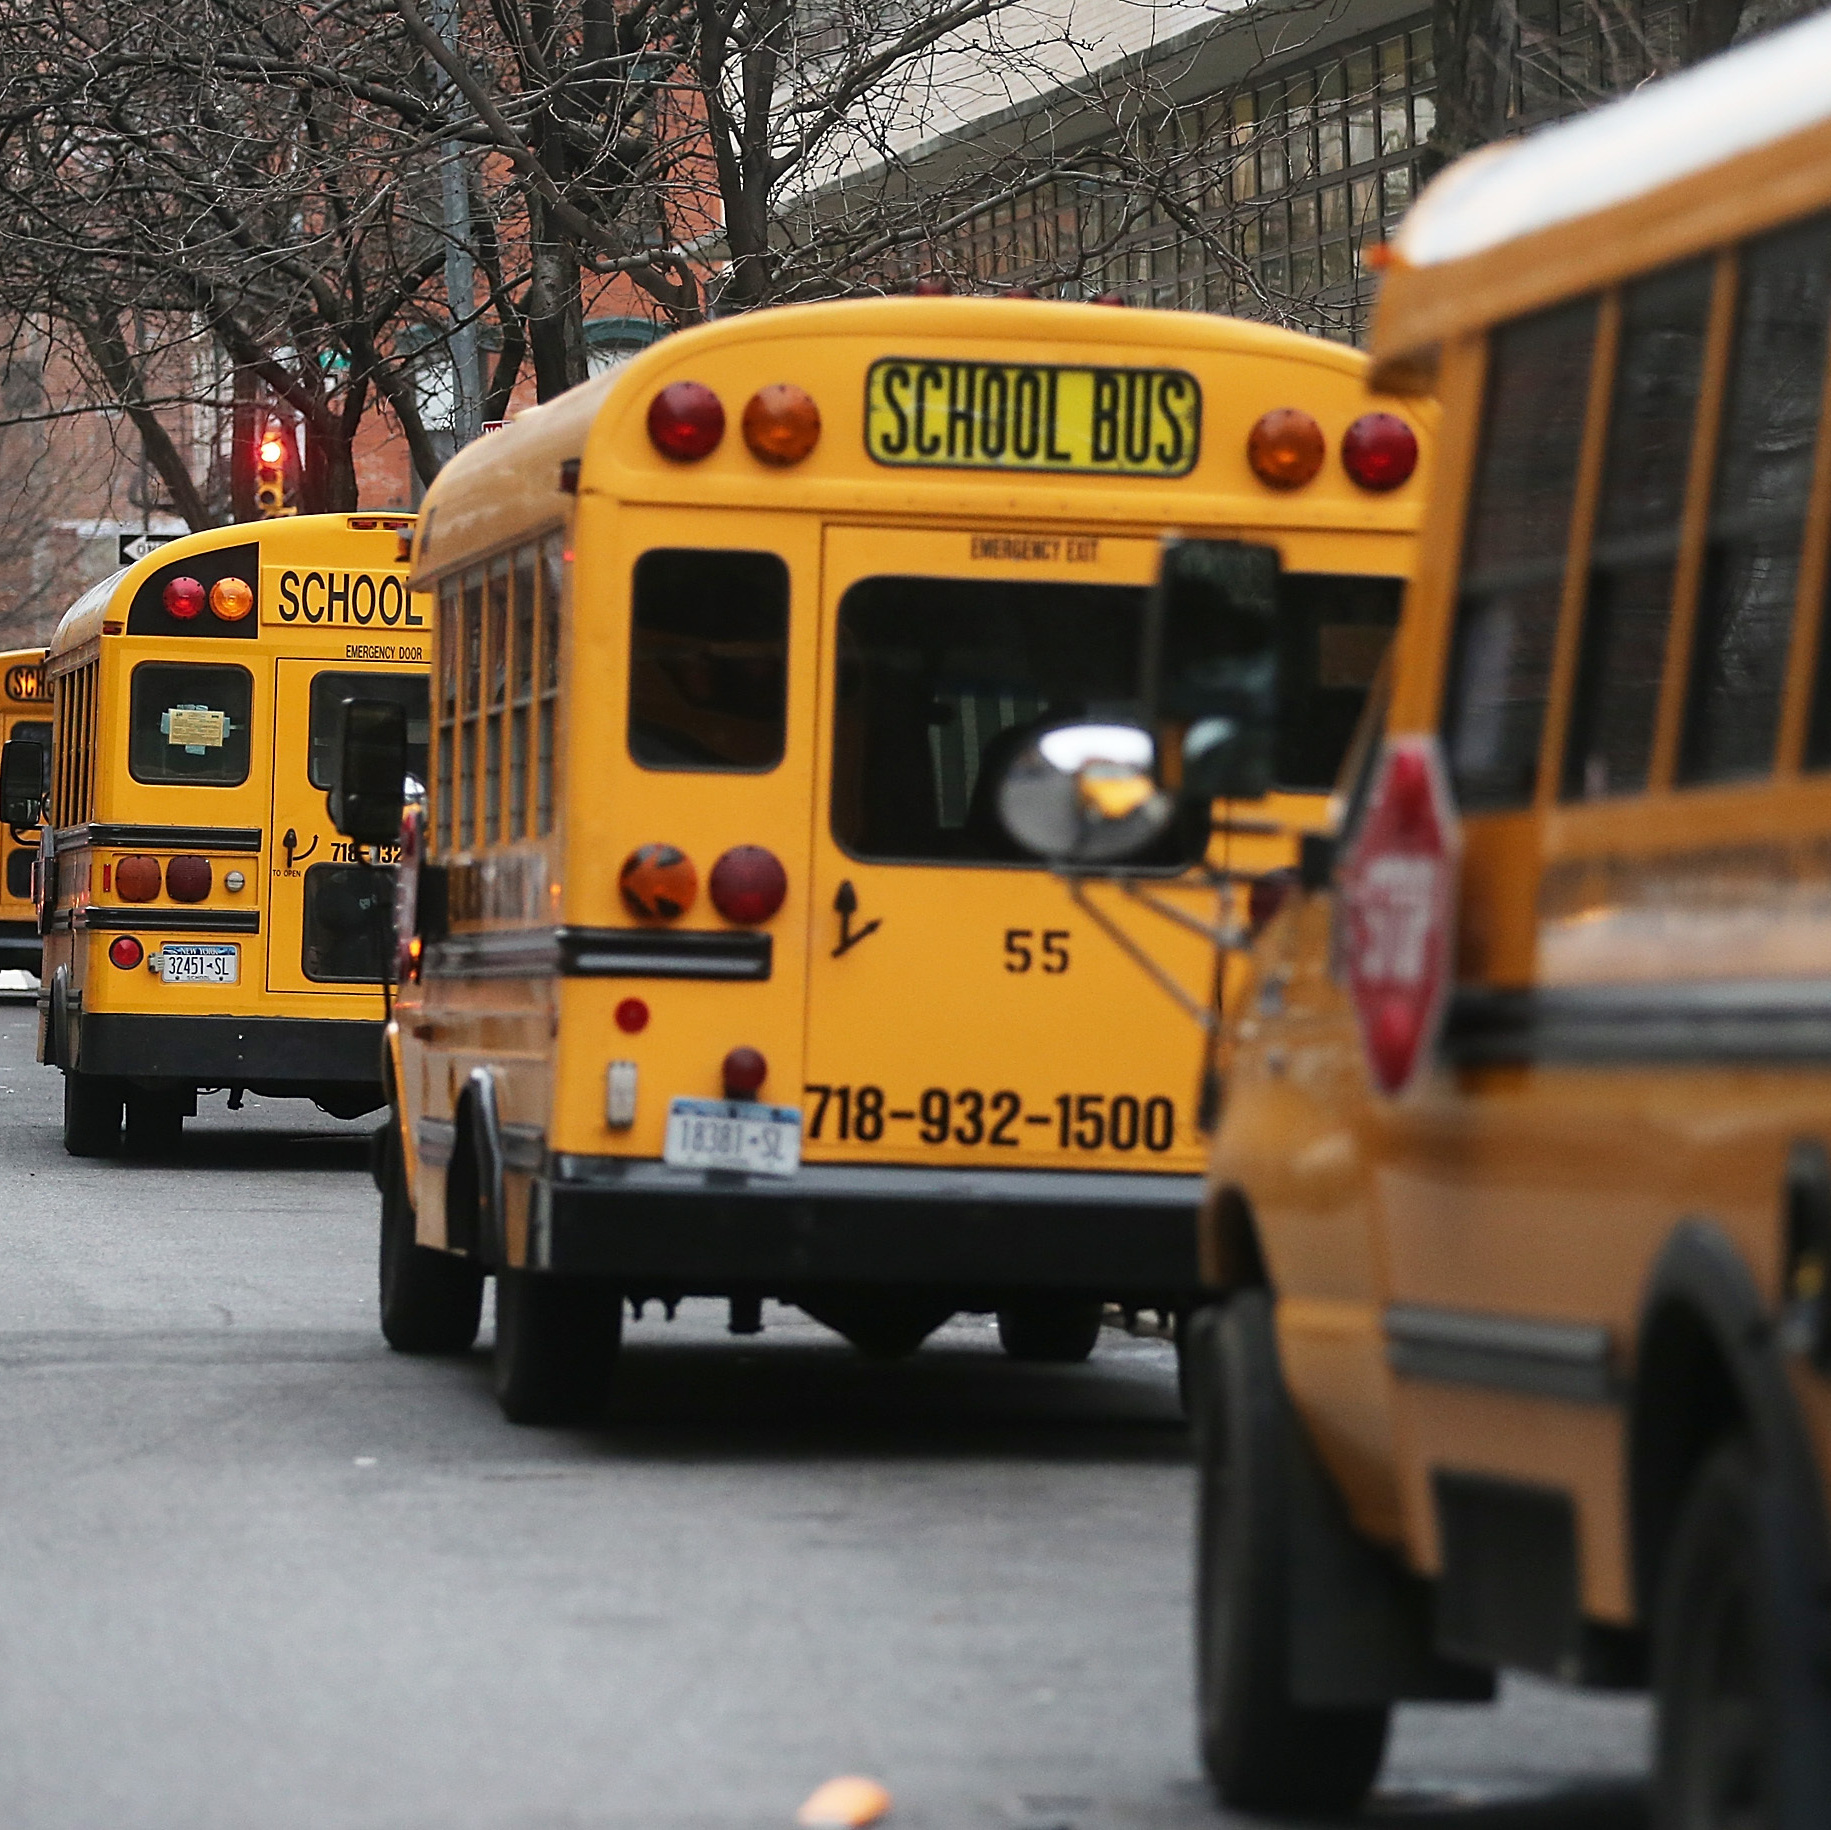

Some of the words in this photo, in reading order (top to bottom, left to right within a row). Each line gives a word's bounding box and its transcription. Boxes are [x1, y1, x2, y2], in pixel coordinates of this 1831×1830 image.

[880, 366, 1071, 461] SCHOOL
[1091, 369, 1186, 465] BUS
[970, 537, 1060, 560] EMERGENCY
[1066, 540, 1099, 562] EXIT
[278, 570, 423, 626] SCHOOL
[346, 645, 396, 659] EMERGENCY
[399, 647, 423, 660] DOOR
[330, 842, 401, 864] 718-32
[272, 869, 282, 877] TO
[284, 869, 301, 877] OPEN
[180, 947, 197, 955] NEW
[199, 947, 219, 955] YORK
[1004, 929, 1070, 974] 55
[803, 1084, 1175, 1152] 718-932-1500
